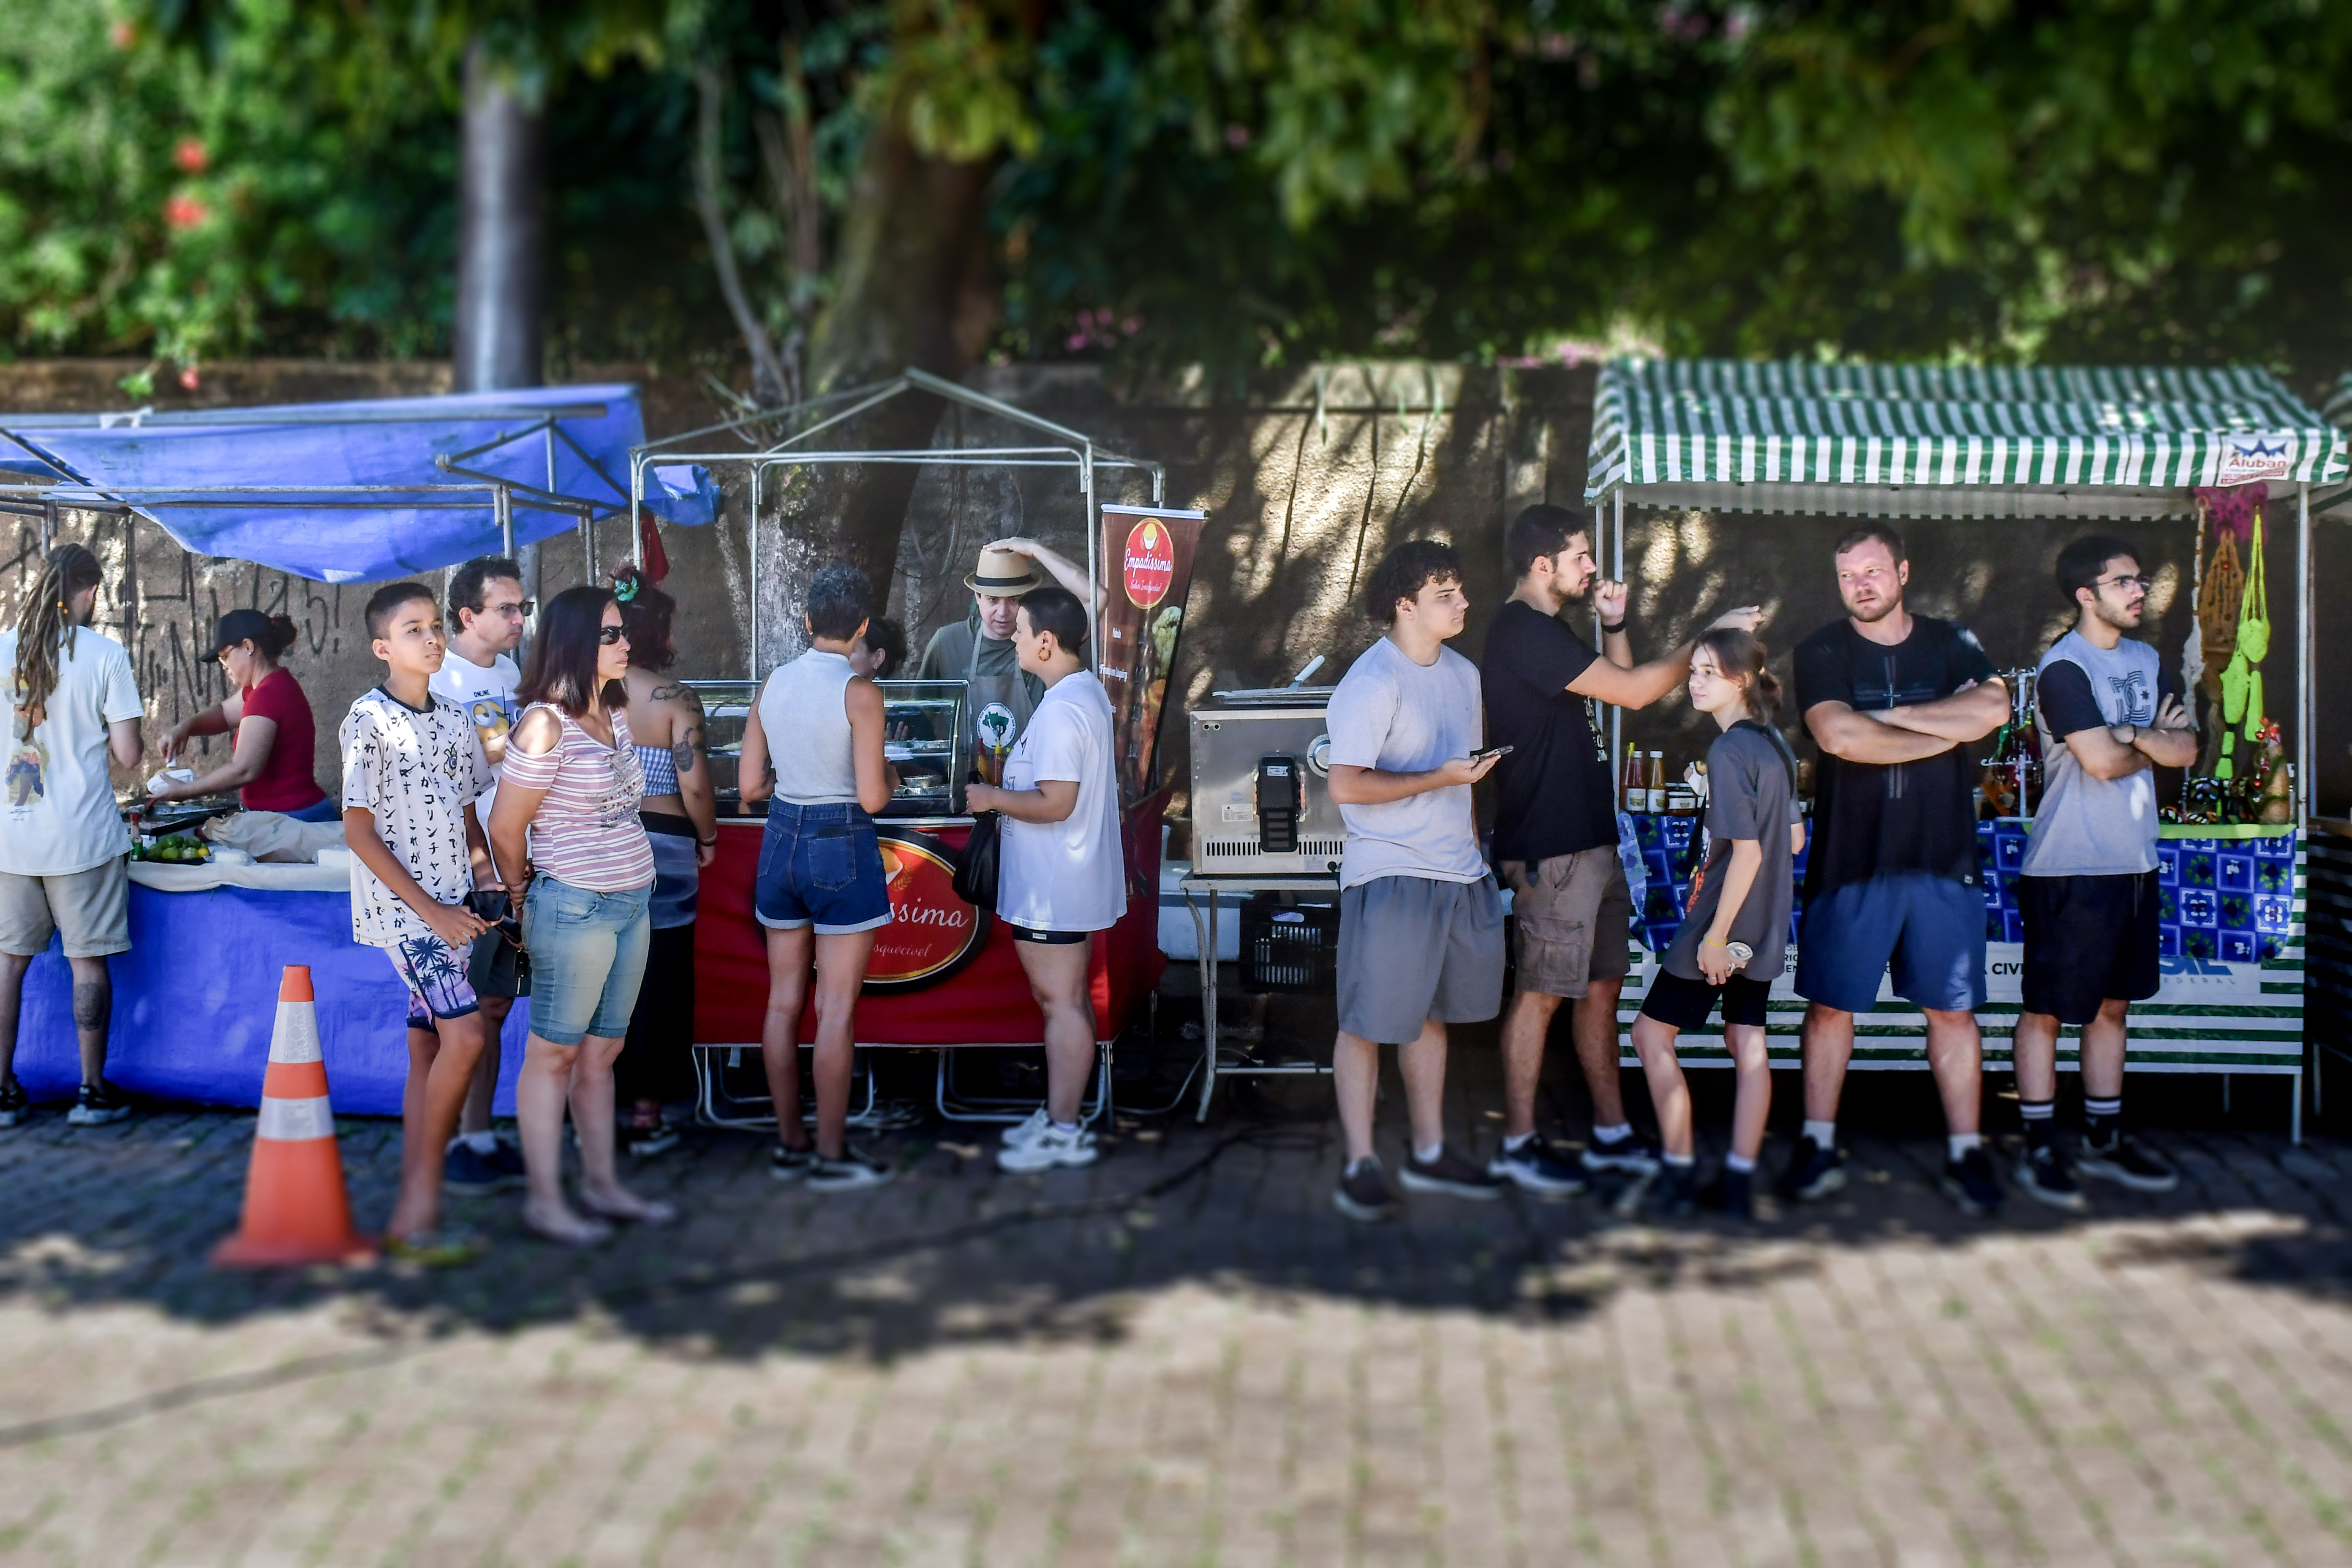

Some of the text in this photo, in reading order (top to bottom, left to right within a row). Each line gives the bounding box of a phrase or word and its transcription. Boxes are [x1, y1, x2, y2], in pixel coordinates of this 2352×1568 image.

[2229, 459, 2287, 468] Aluban
[1124, 548, 1173, 578] Empadíssima
[474, 689, 490, 697] ONLINE
